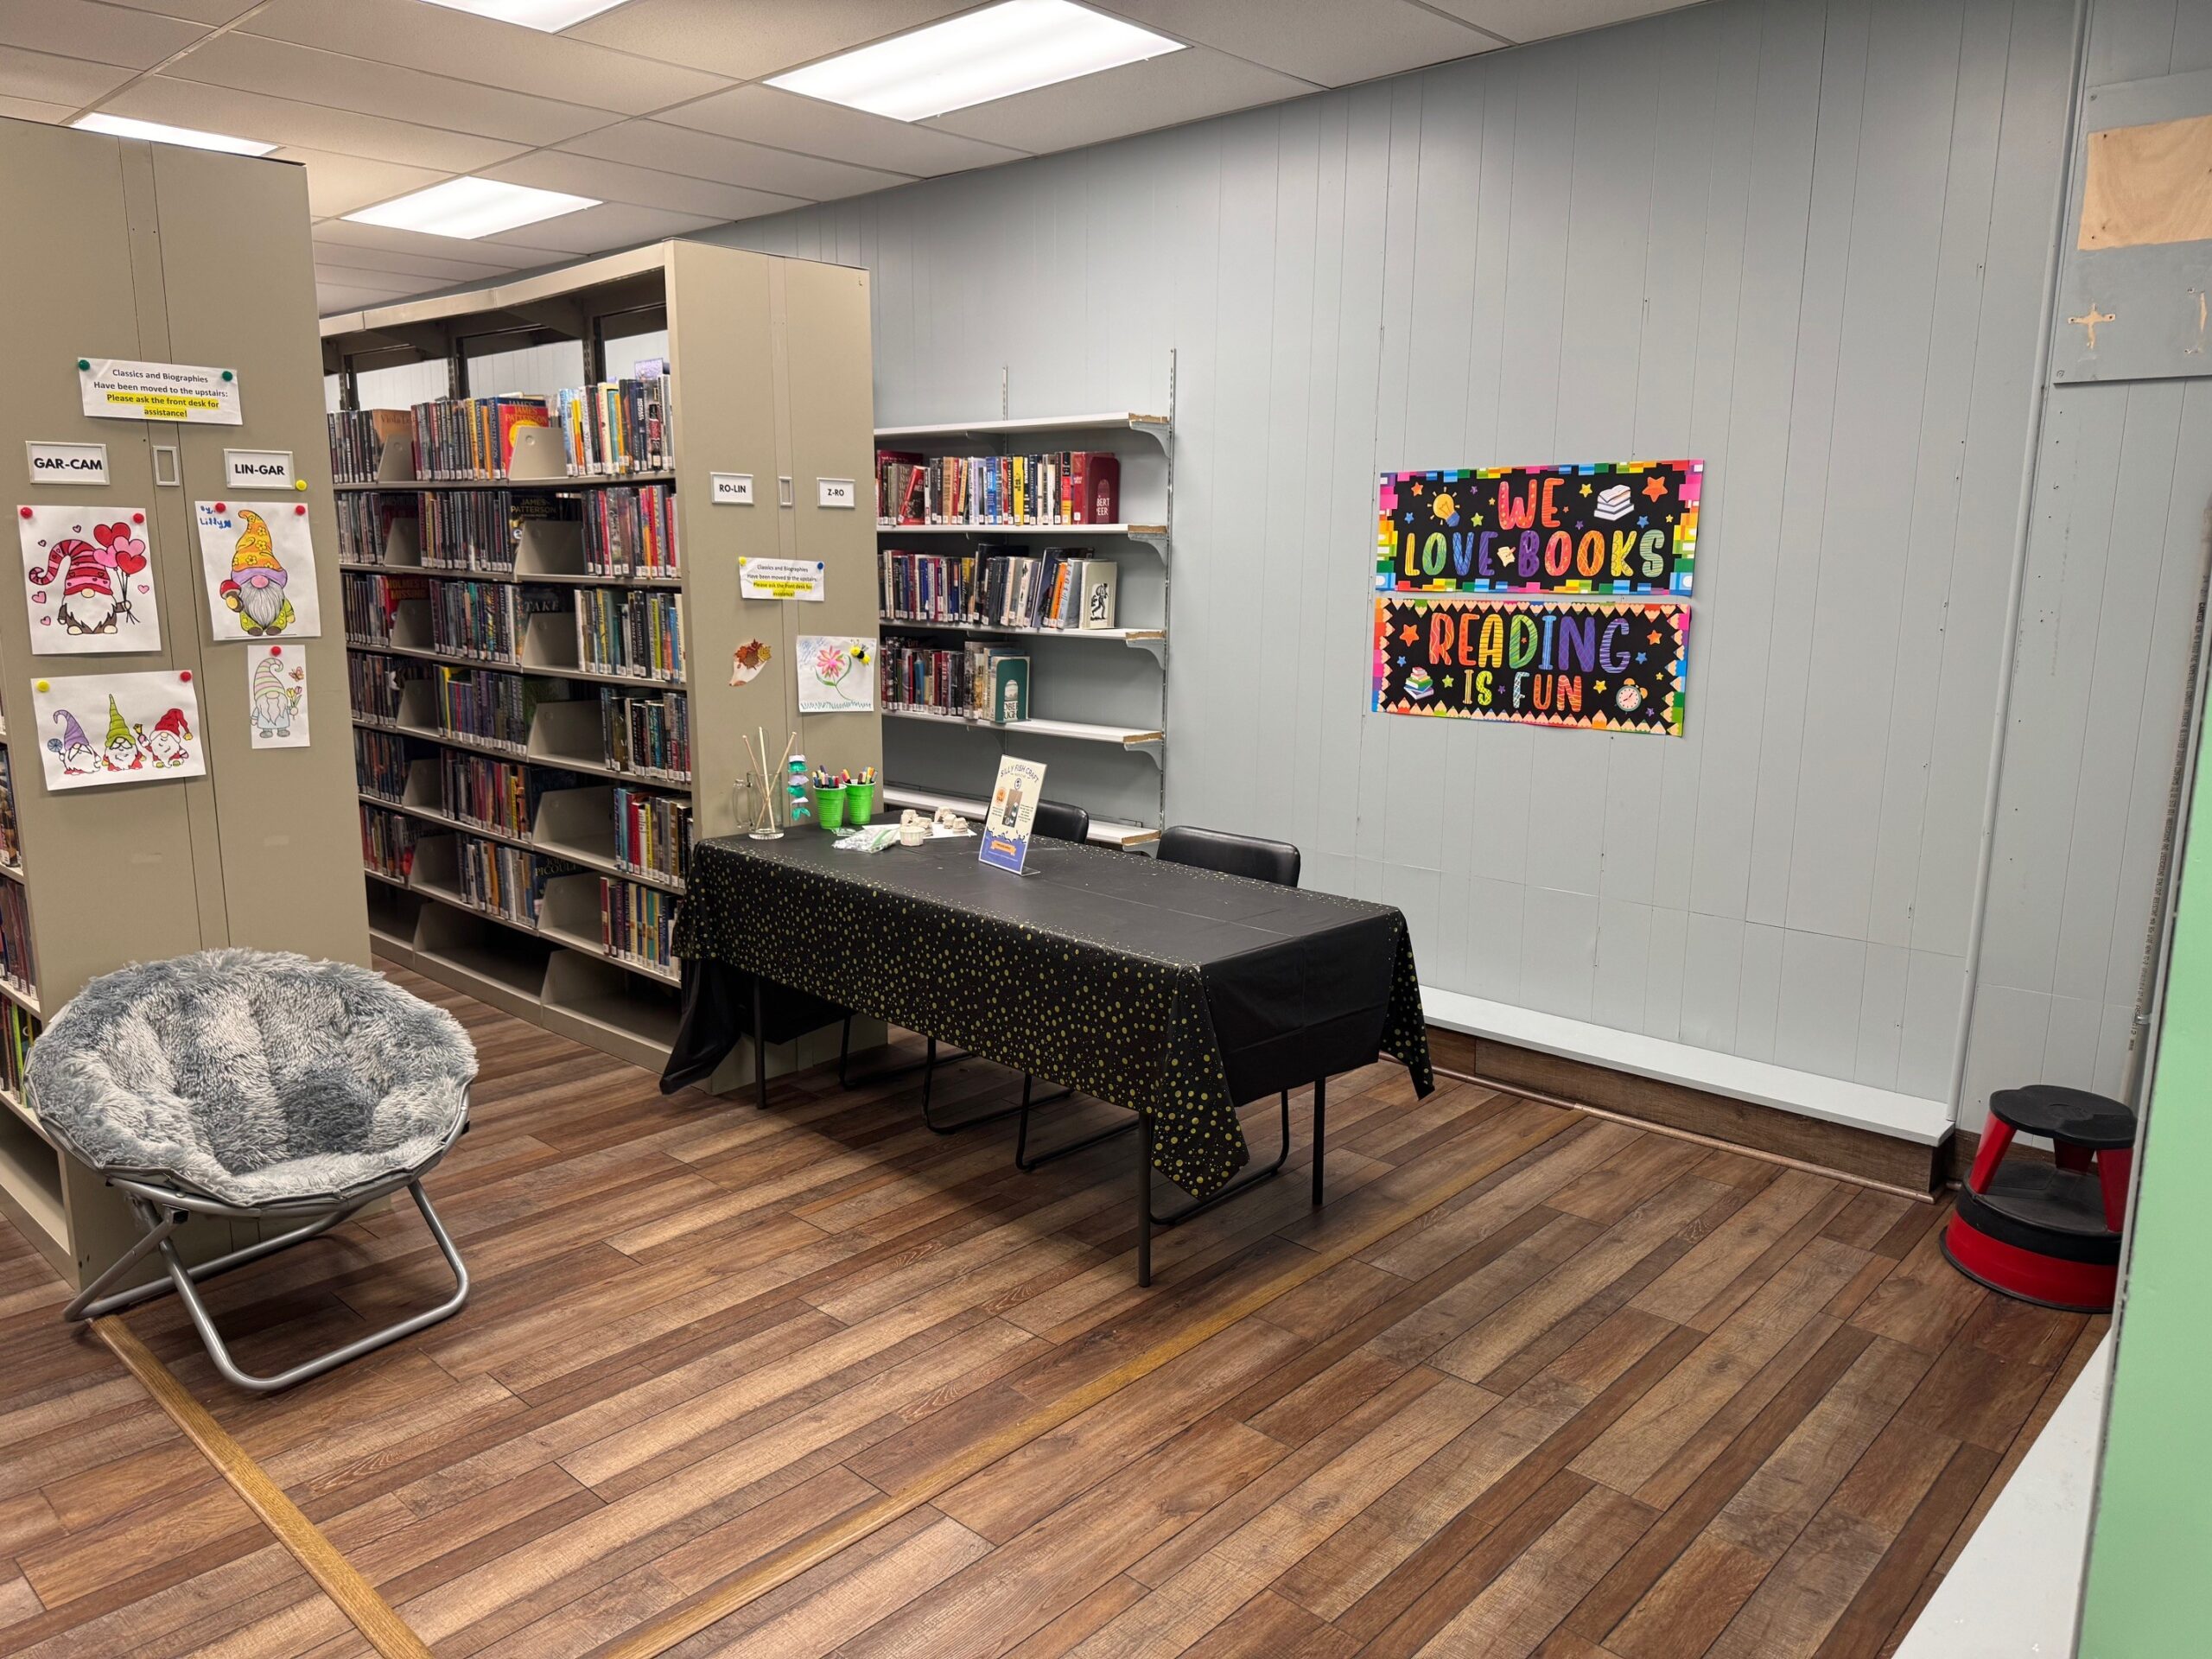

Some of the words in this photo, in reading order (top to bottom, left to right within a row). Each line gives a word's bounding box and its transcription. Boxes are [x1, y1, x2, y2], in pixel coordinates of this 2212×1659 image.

[112, 369, 143, 378] Classics
[162, 372, 209, 384] Biographies
[93, 381, 116, 390] Have
[118, 383, 138, 391] been
[140, 385, 168, 393] moved
[195, 389, 228, 398] upstairs:
[106, 393, 134, 403] Please
[167, 397, 187, 406] front
[188, 399, 206, 408] desk
[207, 400, 219, 409] for
[143, 407, 188, 417] assistance!
[34, 457, 103, 471] GAR-CAM
[234, 463, 285, 476] LIN-GAR
[719, 484, 747, 493] RO-LIN
[827, 488, 845, 497] Z-RO
[1497, 477, 1565, 531] WE
[1404, 531, 1499, 576] LOVE
[1517, 529, 1666, 578] BOOKS
[1429, 612, 1631, 675] READING
[1462, 669, 1493, 707] IS
[1513, 671, 1583, 713] FUN
